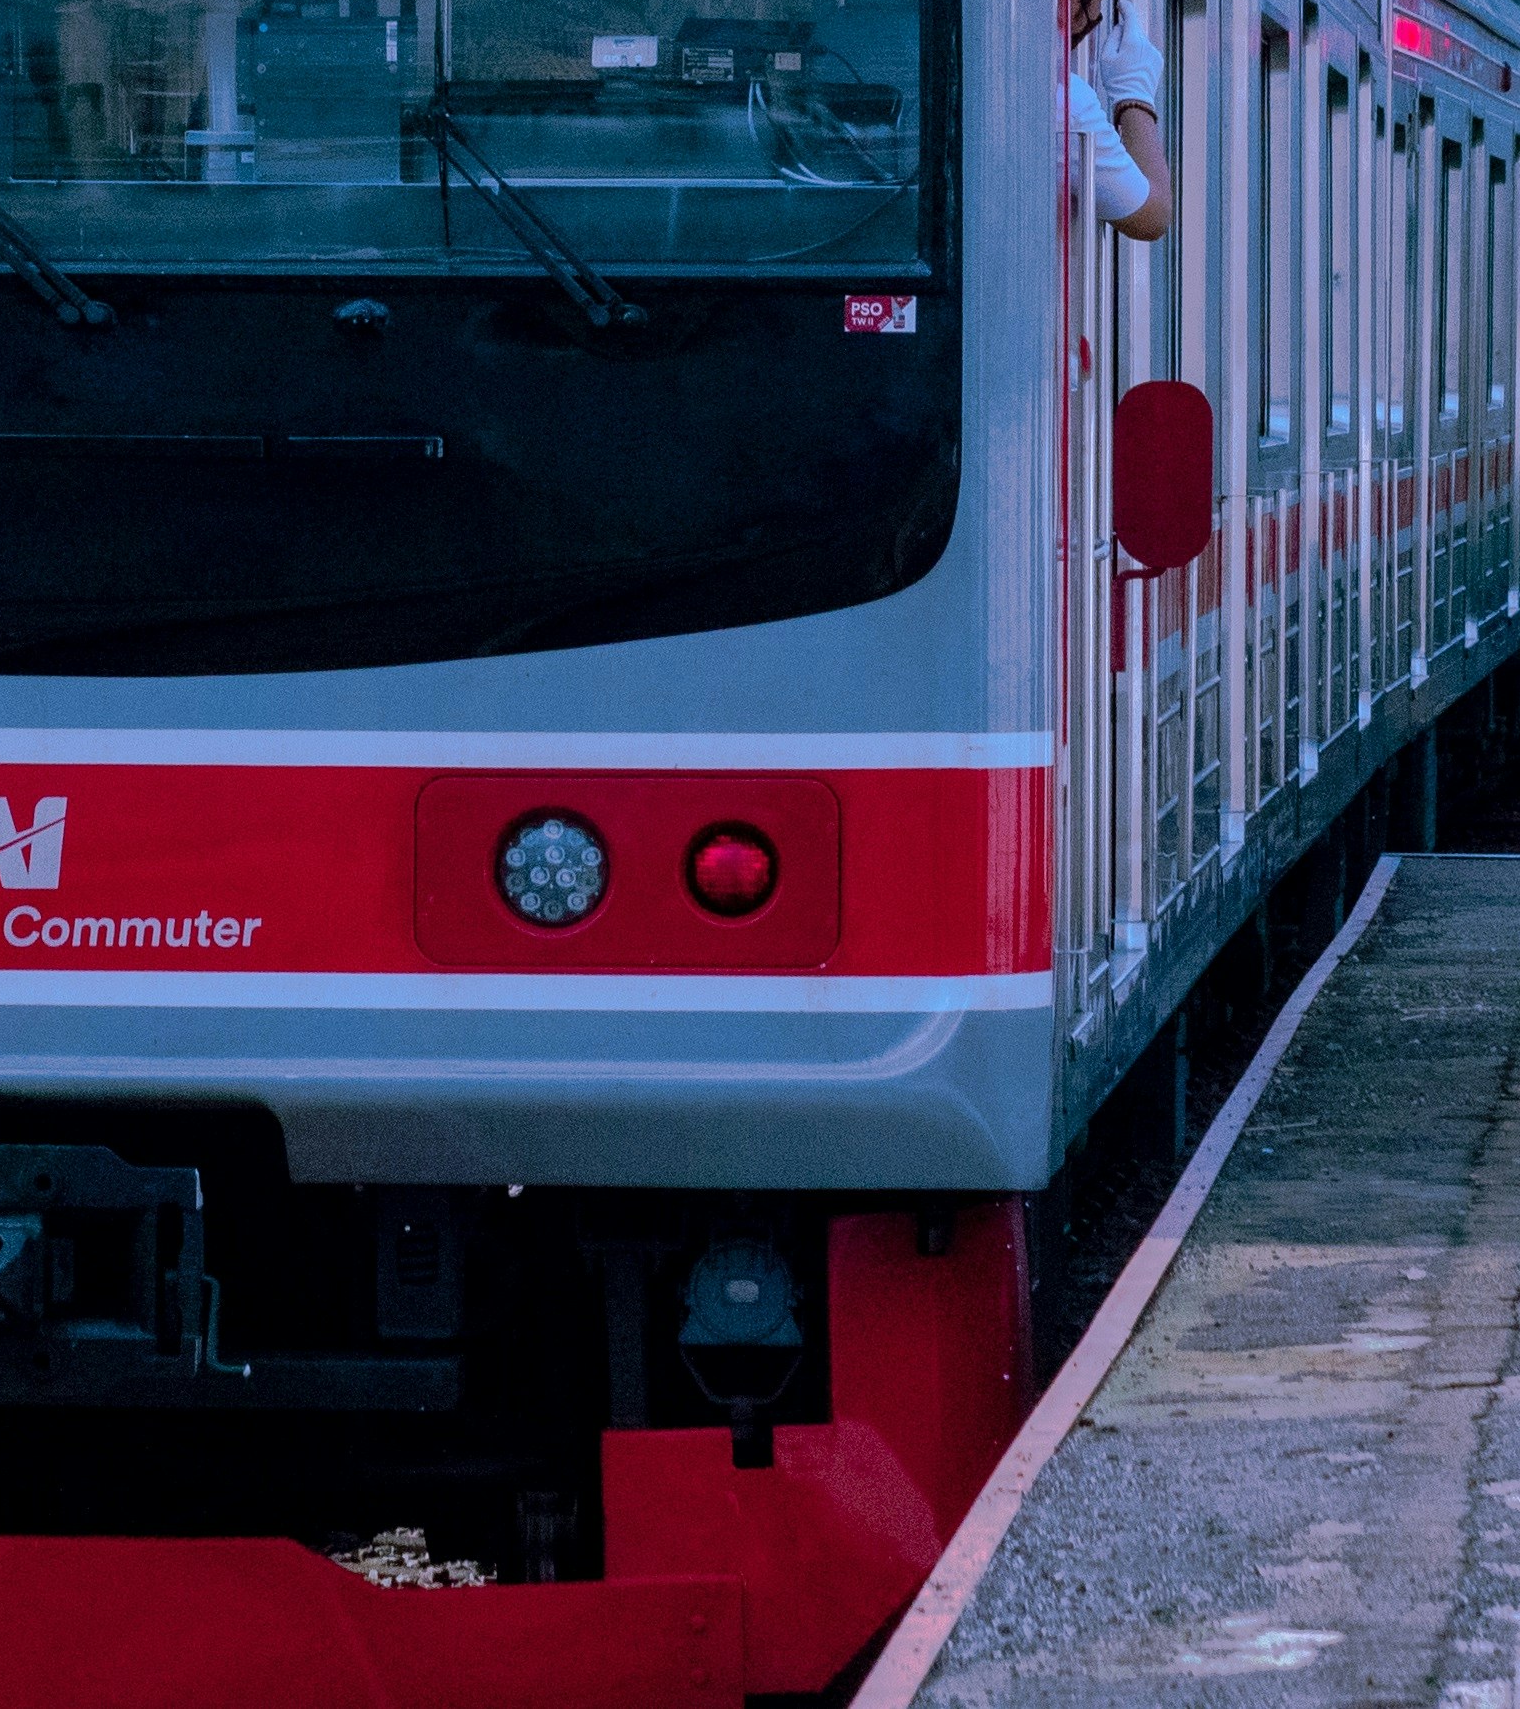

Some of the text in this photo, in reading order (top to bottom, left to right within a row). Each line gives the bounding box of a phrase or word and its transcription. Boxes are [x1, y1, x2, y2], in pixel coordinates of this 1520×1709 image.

[851, 302, 883, 317] PSO
[851, 317, 867, 326] TW
[3, 905, 261, 947] Commuter
